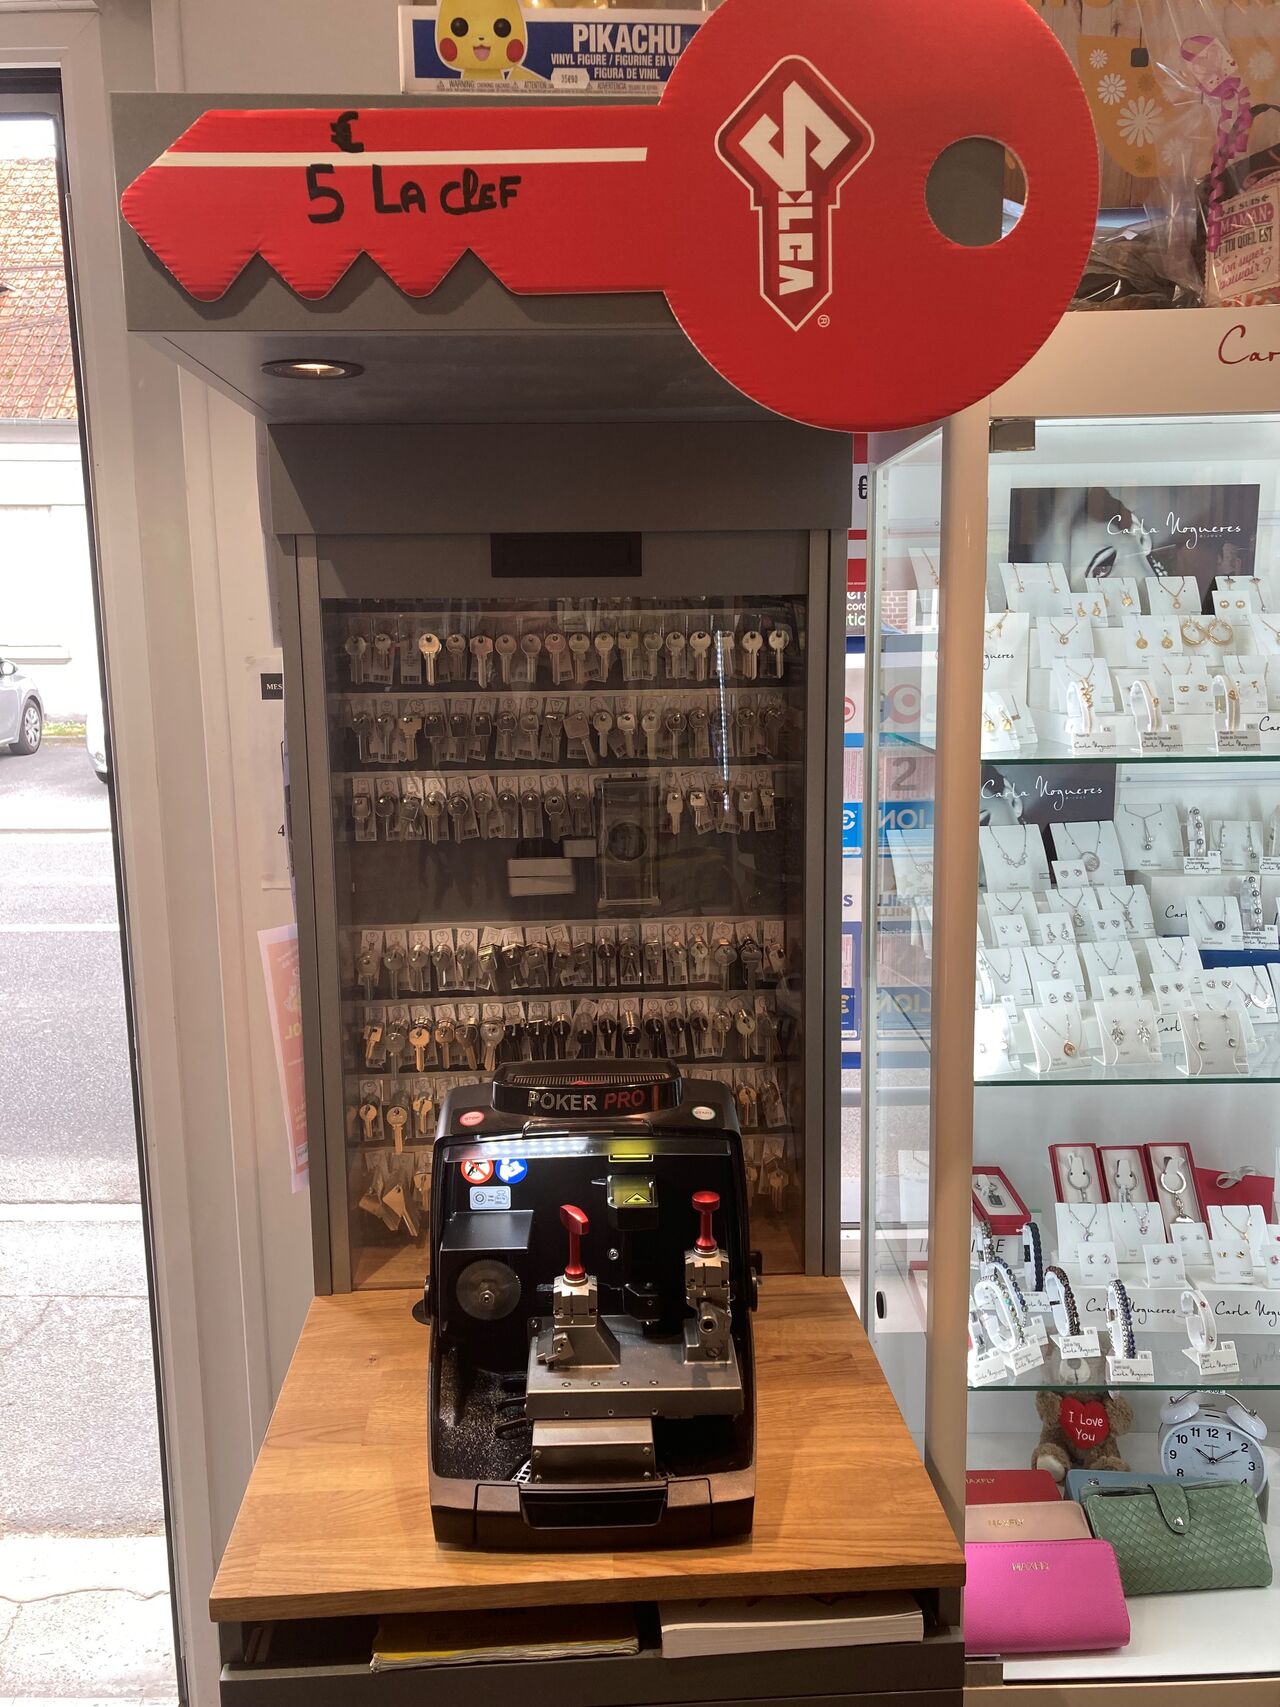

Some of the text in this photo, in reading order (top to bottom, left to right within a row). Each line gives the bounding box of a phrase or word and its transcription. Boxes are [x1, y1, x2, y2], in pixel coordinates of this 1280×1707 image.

[572, 23, 682, 54] PIKACHU
[551, 53, 576, 65] VINYL
[577, 54, 607, 66] FIGURE
[615, 54, 653, 66] FIGURINE
[654, 55, 668, 66] EN
[594, 67, 660, 80] FIGURA DE VINIL
[330, 110, 364, 153] €
[306, 163, 345, 224] 5
[372, 164, 427, 214] LA
[1220, 203, 1268, 234] MAMAN
[1237, 231, 1257, 250] QUEL
[1259, 226, 1274, 243] EST
[1217, 325, 1280, 365] Car
[1107, 512, 1241, 550] Carla Nogueres
[980, 775, 1103, 811] Carla Nogueres
[277, 823, 286, 838] 4
[527, 1089, 646, 1111] POKER PRO
[1214, 1300, 1251, 1316] Carla
[1069, 1411, 1104, 1427] I Love
[1075, 1426, 1096, 1441] You
[1176, 1434, 1188, 1444] 10
[1190, 1427, 1201, 1438] 11
[1206, 1428, 1219, 1438] 12
[1226, 1431, 1232, 1441] 1
[1169, 1449, 1177, 1459] 9
[1240, 1442, 1249, 1453] 2
[1248, 1461, 1256, 1471] 3
